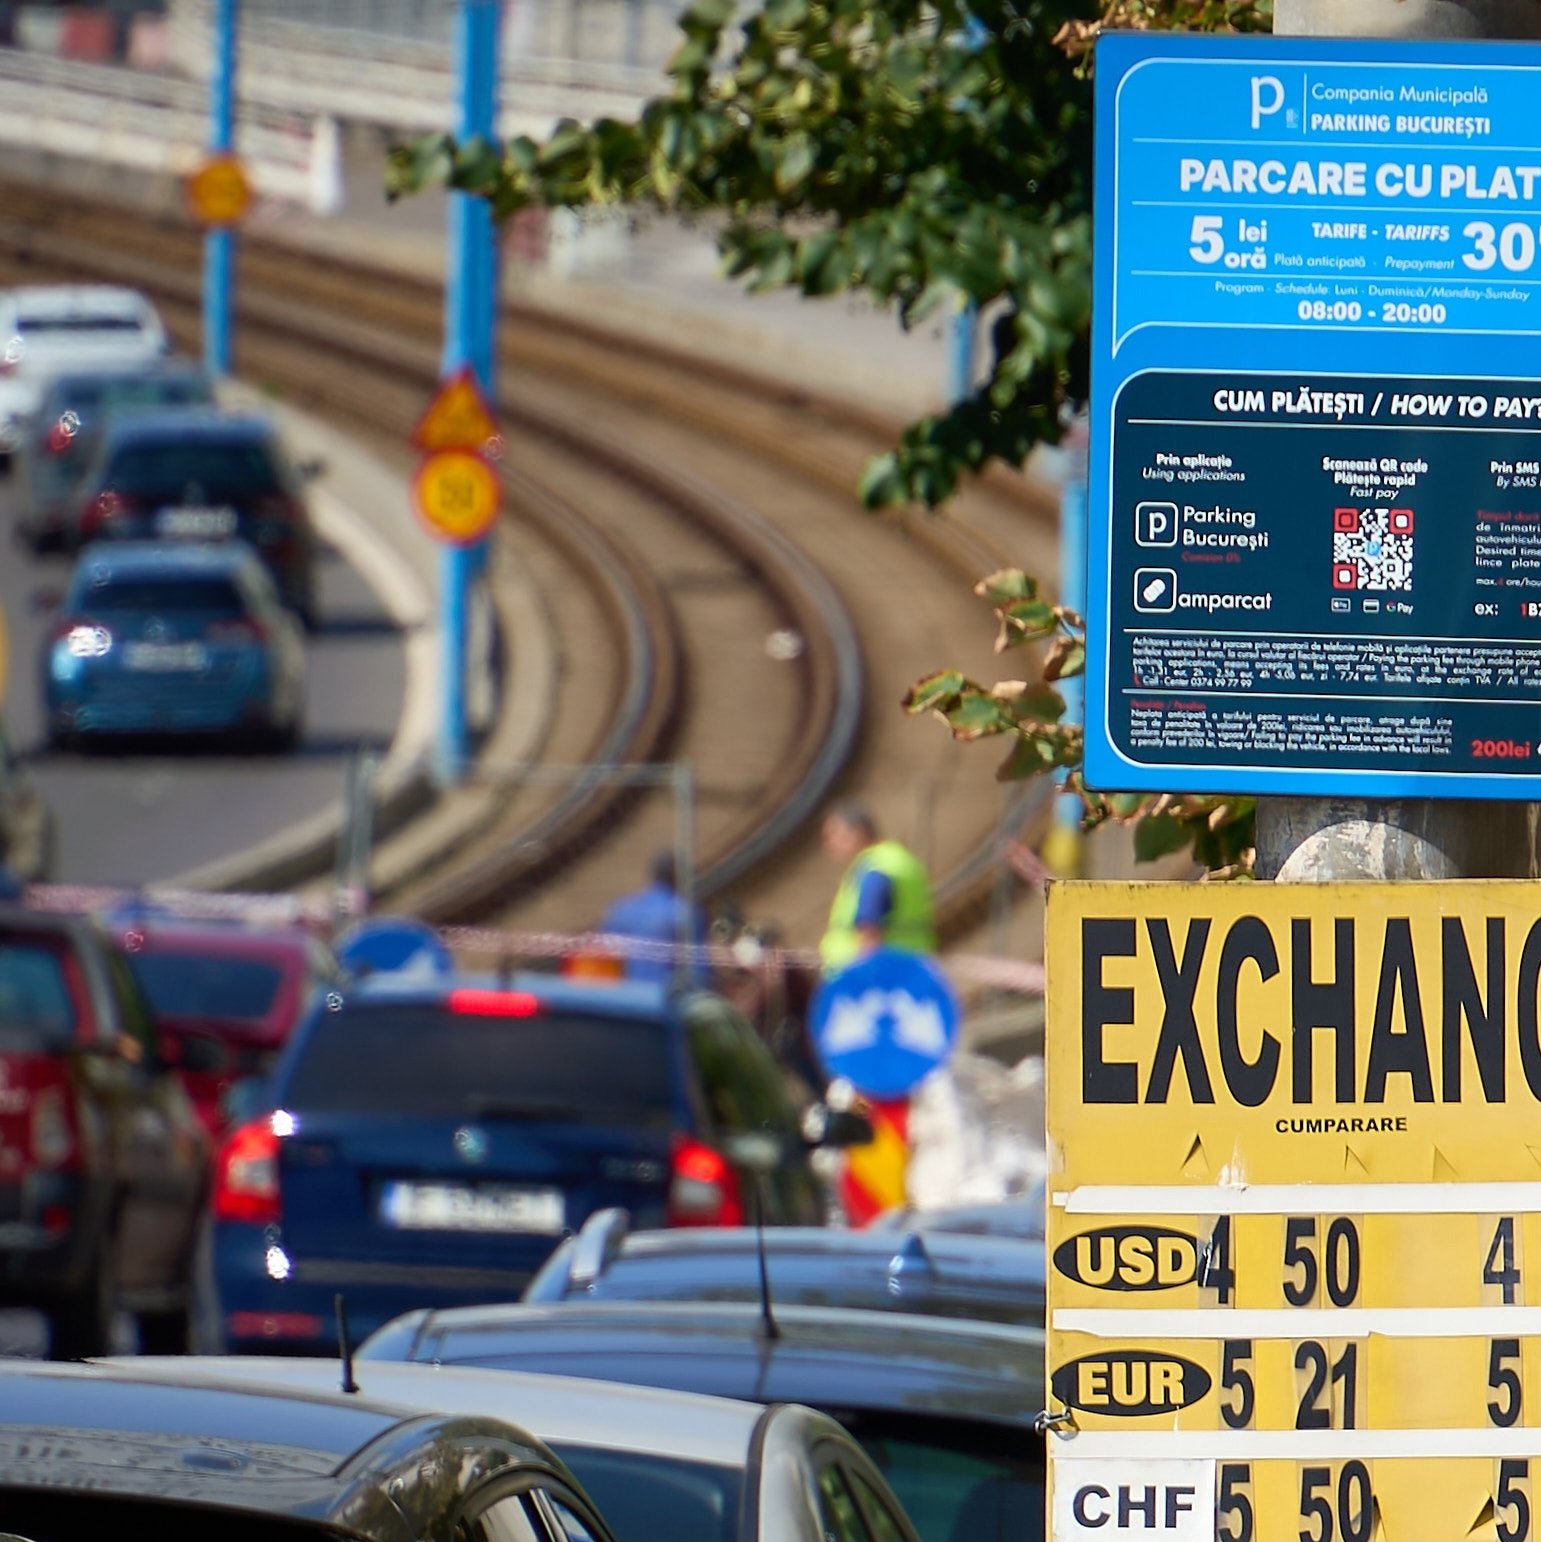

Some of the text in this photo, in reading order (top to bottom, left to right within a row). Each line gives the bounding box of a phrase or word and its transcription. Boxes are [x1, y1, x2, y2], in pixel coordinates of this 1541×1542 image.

[1311, 82, 1488, 107] Compania Municipală
[1311, 113, 1391, 133] PARKING
[1180, 159, 1366, 196] PARCARE
[1375, 164, 1432, 198] CU
[1189, 215, 1268, 264] 5 lei
[1312, 222, 1367, 240] TARIFE
[1384, 224, 1450, 242] TARIFFS
[1461, 220, 1535, 272] 30
[1224, 247, 1267, 269] oră
[1274, 252, 1455, 271] Plată anticipată Prepayment
[1214, 280, 1265, 296] Program
[1334, 283, 1358, 296] Luni
[1297, 300, 1362, 321] 08:00
[1382, 302, 1446, 324] 20:00
[1214, 389, 1265, 412] CUM
[1272, 386, 1365, 421] PLĂTEȘTI
[1390, 394, 1454, 417] HOW
[1458, 396, 1488, 417] TO
[1156, 453, 1180, 467] Prin
[1322, 456, 1429, 473] Scanează QR code
[1490, 460, 1513, 475] Prin
[1515, 461, 1540, 475] SMS
[1142, 467, 1246, 483] Using applications
[1383, 473, 1416, 488] rapid
[1496, 476, 1509, 489] By
[1512, 476, 1537, 488] SMS
[1350, 485, 1399, 500] Fast pay
[1183, 505, 1256, 529] Parking
[1475, 522, 1491, 533] de
[1182, 528, 1269, 552] București
[1475, 545, 1517, 557] Desired
[1475, 556, 1503, 567] lince
[1511, 558, 1541, 570] plate
[1178, 592, 1273, 614] amparcat
[1397, 601, 1414, 616] Pay
[1474, 603, 1499, 616] ex:
[1471, 739, 1531, 758] 200lei
[1274, 1115, 1409, 1135] CUMPARARE
[1075, 1235, 1197, 1286] USD
[1202, 1214, 1235, 1305] 4
[1282, 1216, 1360, 1307] 50
[1483, 1216, 1521, 1305] 4
[1076, 1361, 1187, 1407] EUR
[1219, 1338, 1255, 1429] 5
[1294, 1340, 1357, 1430] 21
[1487, 1338, 1522, 1428] 5
[1072, 1484, 1197, 1529] CHF
